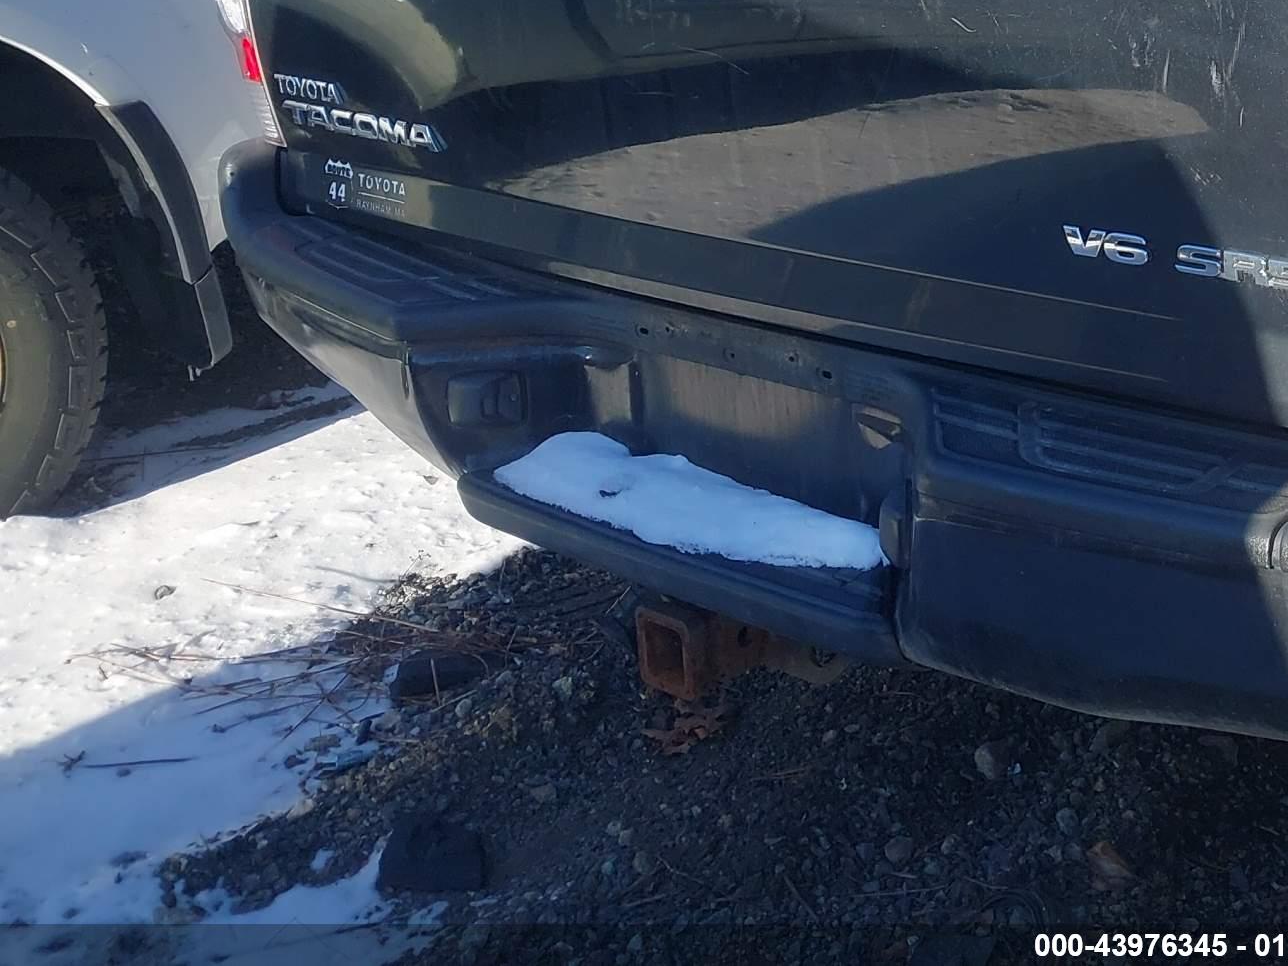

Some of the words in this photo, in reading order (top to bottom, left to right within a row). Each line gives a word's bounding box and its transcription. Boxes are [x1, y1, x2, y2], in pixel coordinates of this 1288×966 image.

[274, 74, 341, 105] TOYOTA
[282, 99, 441, 153] TACOMA
[329, 181, 346, 202] 44
[358, 173, 406, 195] TOYOTA
[1063, 225, 1149, 266] V6
